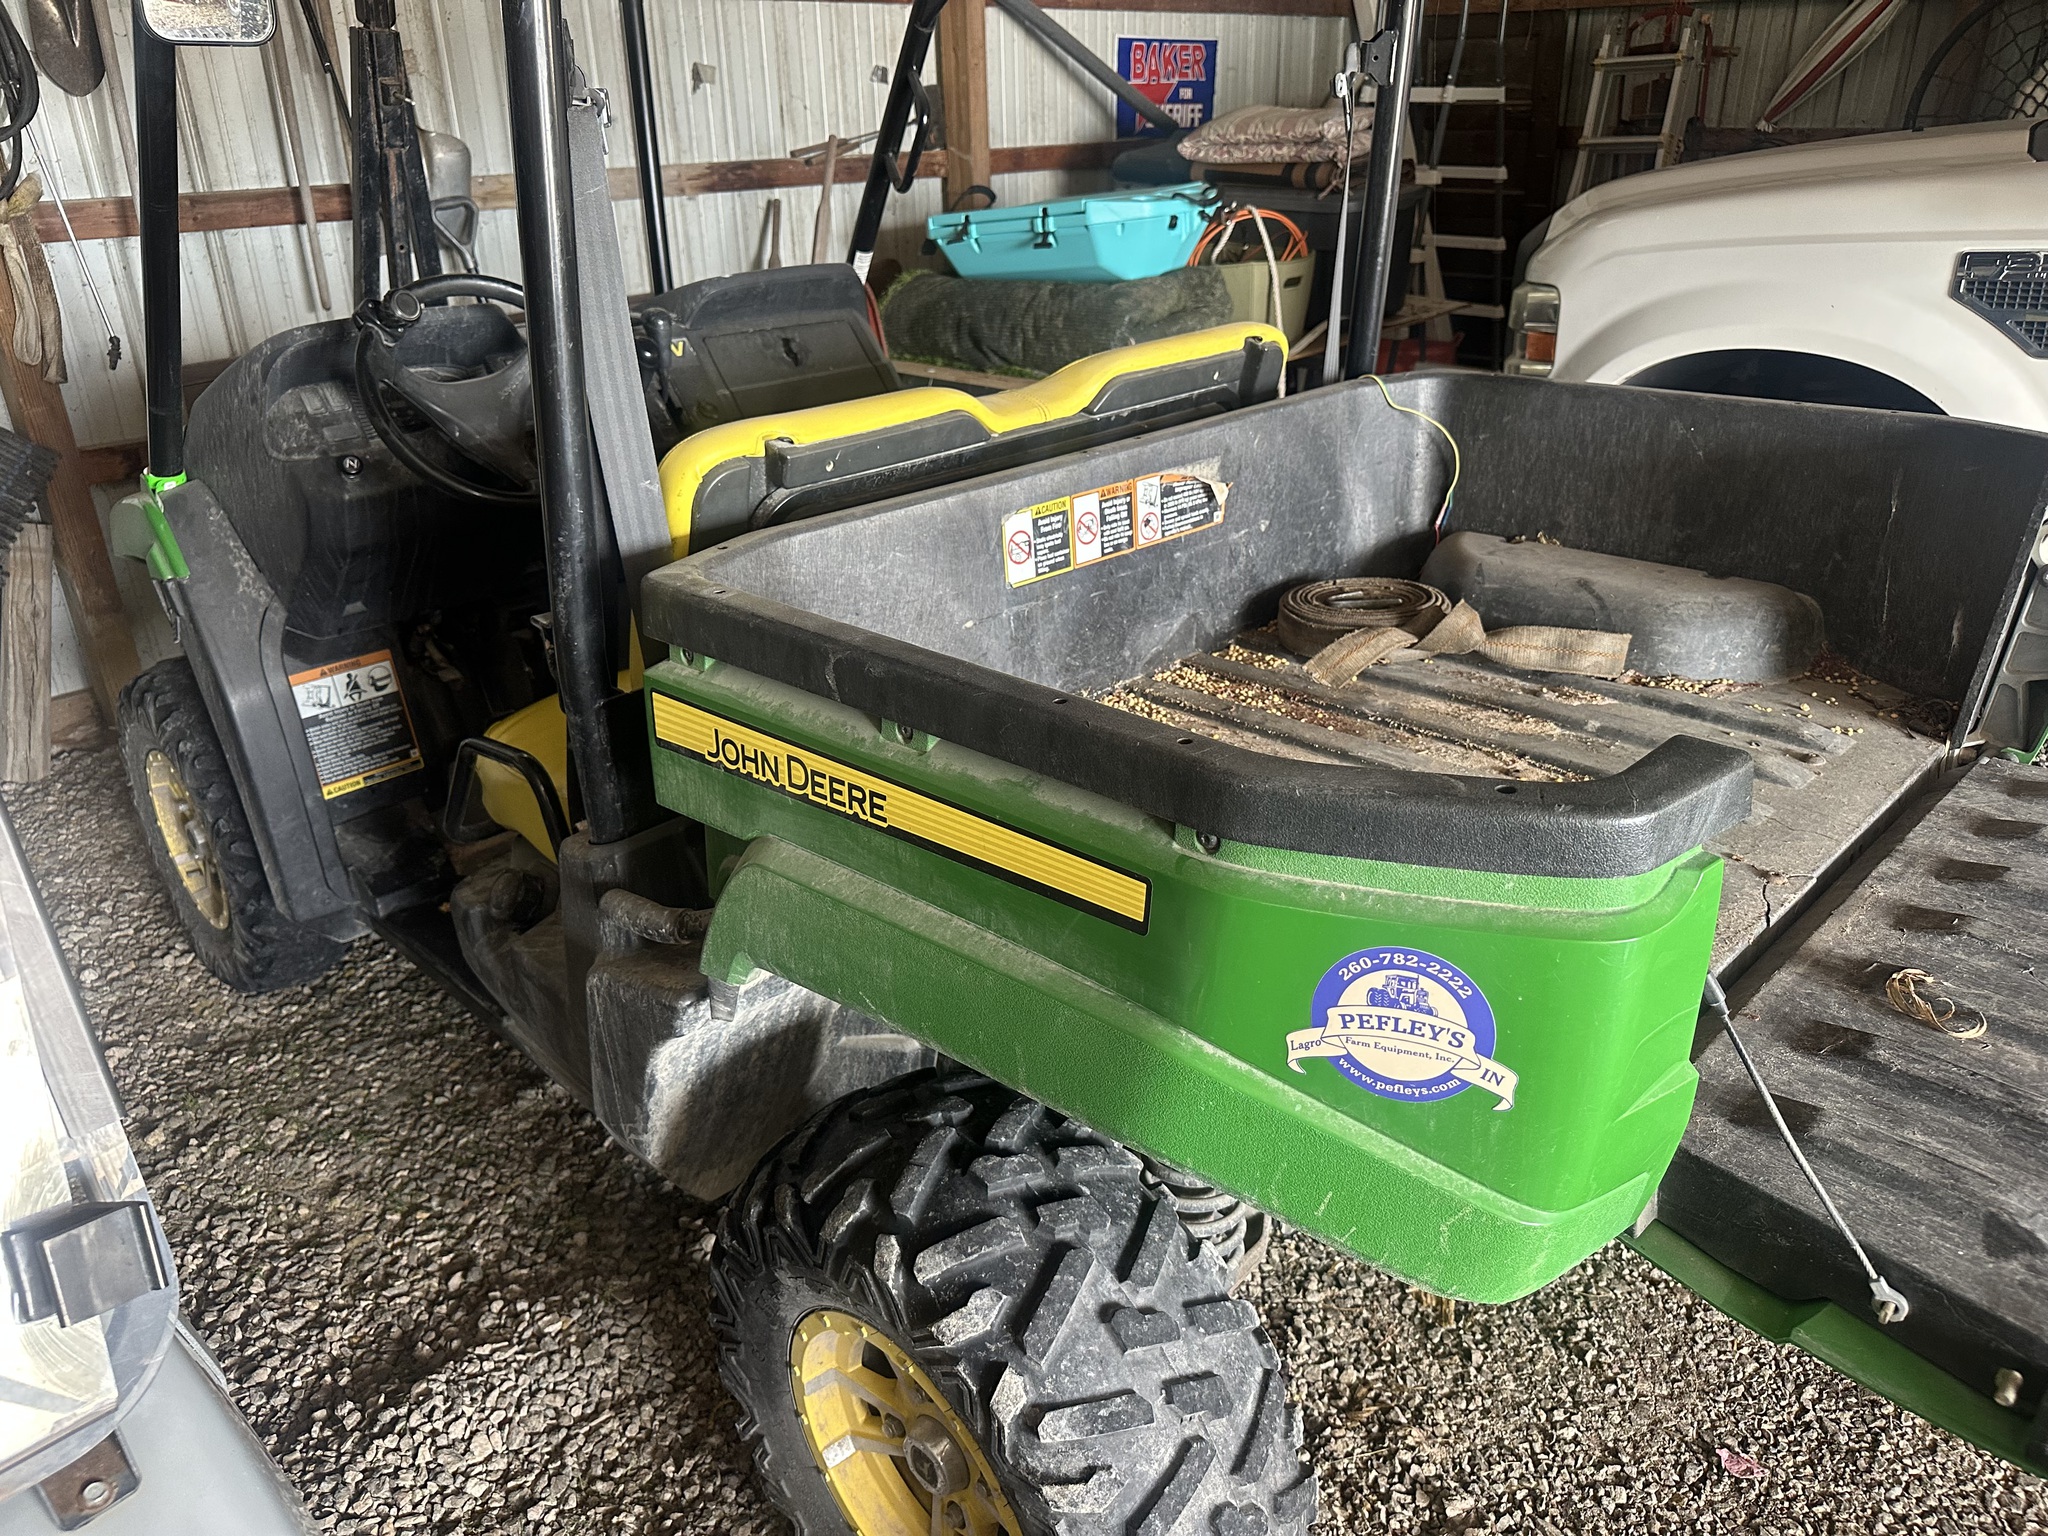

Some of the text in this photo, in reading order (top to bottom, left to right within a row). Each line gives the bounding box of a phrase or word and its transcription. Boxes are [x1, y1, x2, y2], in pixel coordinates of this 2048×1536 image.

[1130, 42, 1206, 84] BAKER
[1145, 103, 1203, 128] ERIFF
[1106, 482, 1133, 497] WARNING
[1041, 500, 1067, 514] CAUTION
[333, 780, 361, 793] CAUTION
[706, 728, 888, 825] JOHN DEERE
[1338, 953, 1473, 999] 260-782-2222
[1337, 1013, 1466, 1049] PEFLEY'S
[1290, 1038, 1322, 1051] Lagro
[1345, 1036, 1455, 1063] Farm Equipment, Inc.
[1339, 1057, 1462, 1097] www.pefleys.com
[1480, 1067, 1506, 1087] IN
